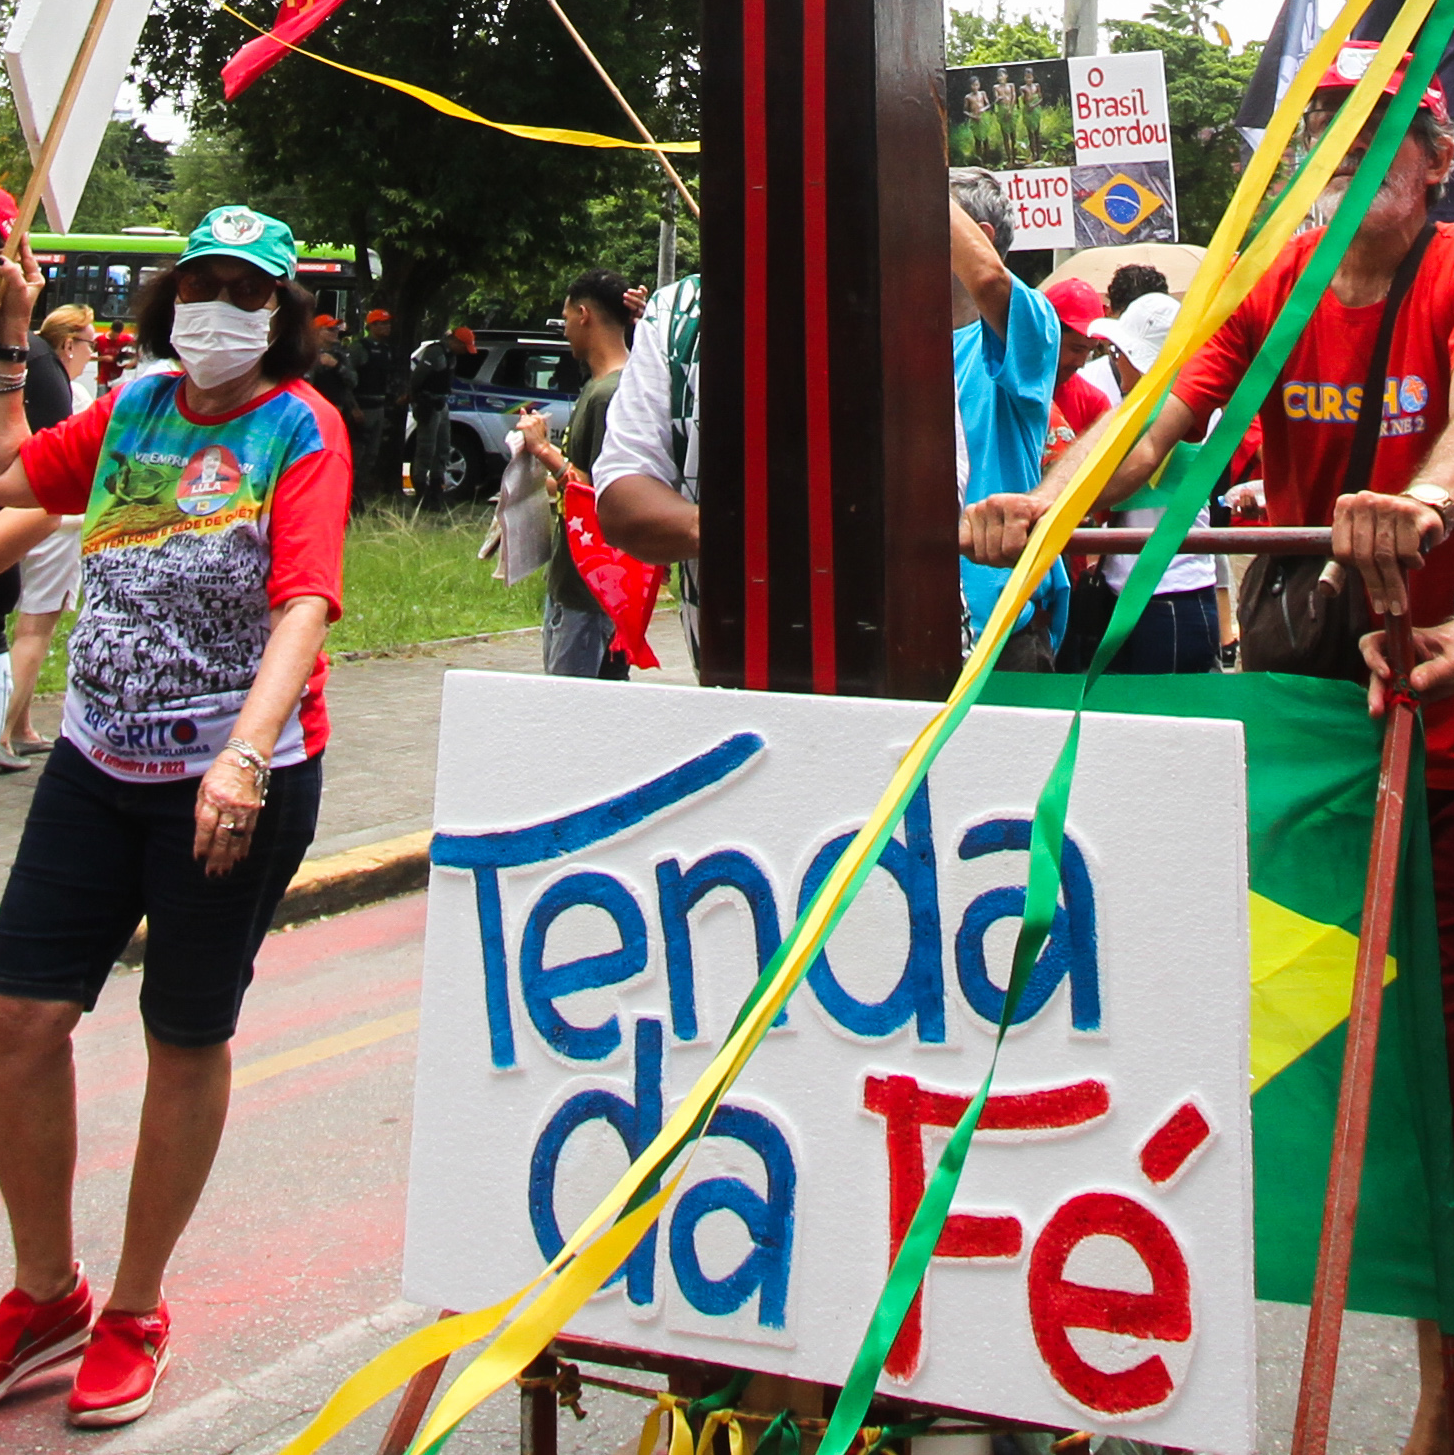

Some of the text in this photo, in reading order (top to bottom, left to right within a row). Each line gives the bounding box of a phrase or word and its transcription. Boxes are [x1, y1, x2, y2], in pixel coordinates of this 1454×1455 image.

[1075, 88, 1150, 120] Brasil
[1074, 119, 1168, 150] acordou
[1013, 202, 1063, 230] tou
[1414, 415, 1426, 432] 2
[191, 480, 222, 494] LULA
[170, 518, 202, 535] SEDE
[204, 516, 222, 528] DE
[106, 718, 198, 749] GRITO
[160, 760, 186, 774] 2023
[428, 731, 1102, 1070] Tenda
[528, 1018, 1211, 1415] da Fé
